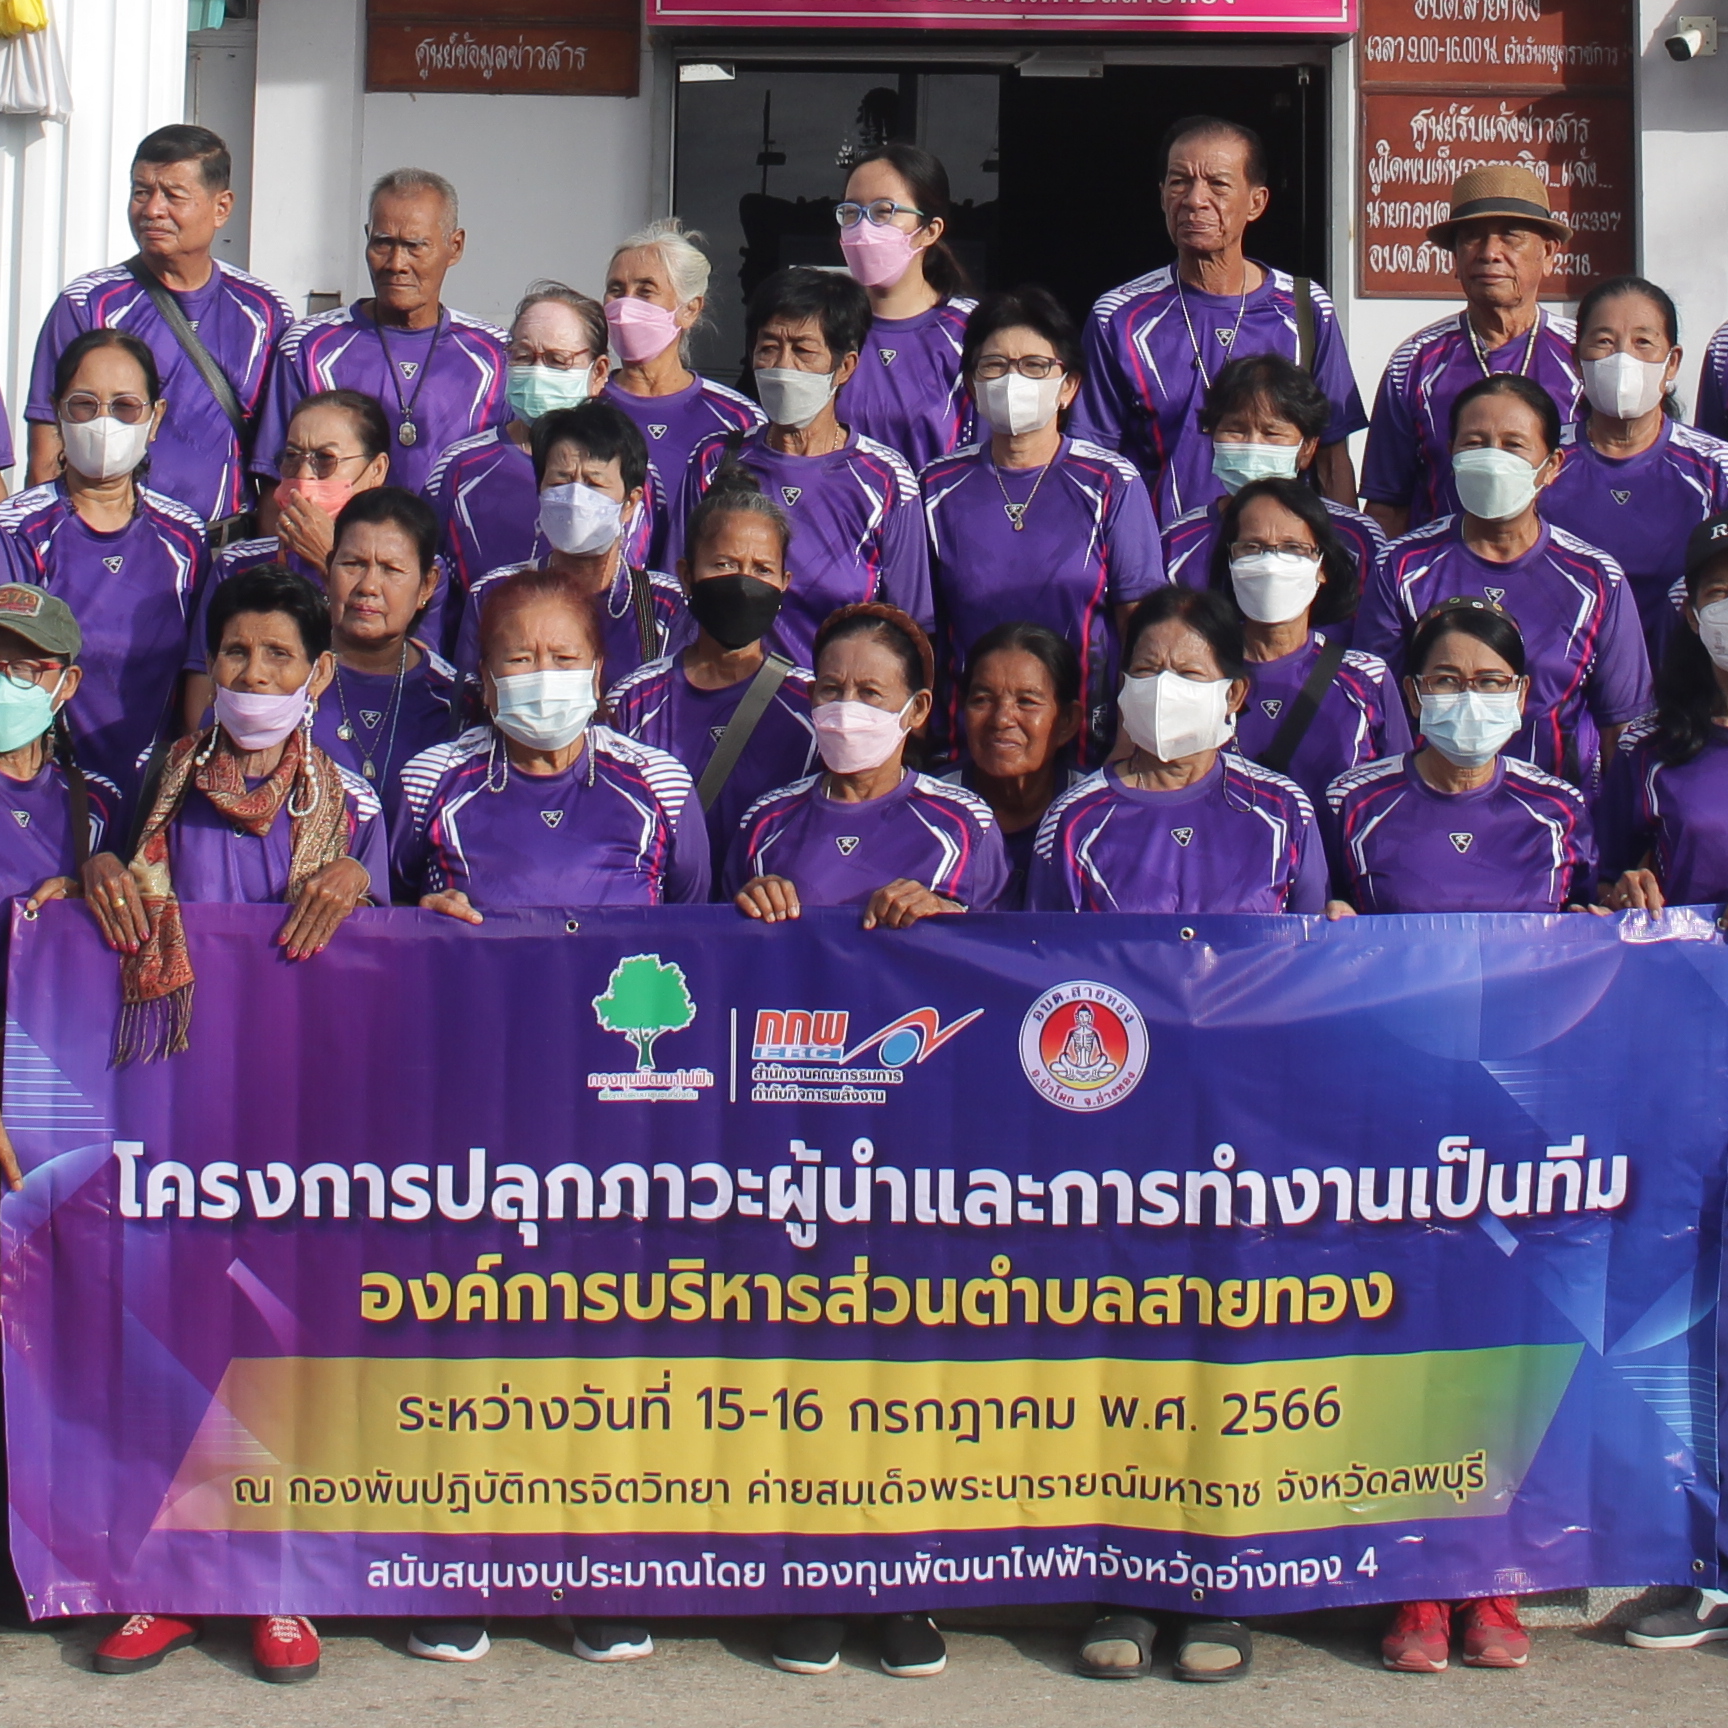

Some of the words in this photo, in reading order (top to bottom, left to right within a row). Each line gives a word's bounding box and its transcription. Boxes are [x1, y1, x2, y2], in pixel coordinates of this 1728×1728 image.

[415, 32, 588, 80] ศูนย์ข้อมูลข่าวสาร
[1410, 101, 1591, 152] ศูนย์รับแจ้งข่าวสาร
[756, 1011, 848, 1047] กกพ
[760, 1046, 832, 1058] ERC
[753, 1063, 902, 1082] สำนักงานคณะกรรมการ
[753, 1083, 884, 1102] กำกับกิจการพลังงาน
[113, 1135, 1629, 1248] โครงการปลุกภาวะผู้นำและการทำงานเป็นทีม
[360, 1254, 1393, 1328] องค์การบริหารส่วนตำบลสายทอง
[399, 1370, 672, 1434] ระหว่างวันที่
[696, 1385, 825, 1433] 15-16
[848, 1395, 1076, 1445] กรกฎาคม
[1099, 1390, 1198, 1435] พ.ศ.
[1220, 1385, 1342, 1436] 2566
[233, 1474, 271, 1507] ณ
[289, 1466, 731, 1515] กองพันปฏิบัติการจิตวิทยา
[747, 1465, 1261, 1510] ค่ายสมเด็จพระนารายณ์มหาราช
[1275, 1449, 1488, 1504] จังหวัดลพบุรี
[367, 1553, 767, 1598] สนับสนุนงบประมาณโดย
[783, 1544, 1340, 1598] กองทุนพัฒนาไฟฟ้าจังหวัดอ่างทอง
[1355, 1549, 1379, 1578] 4
